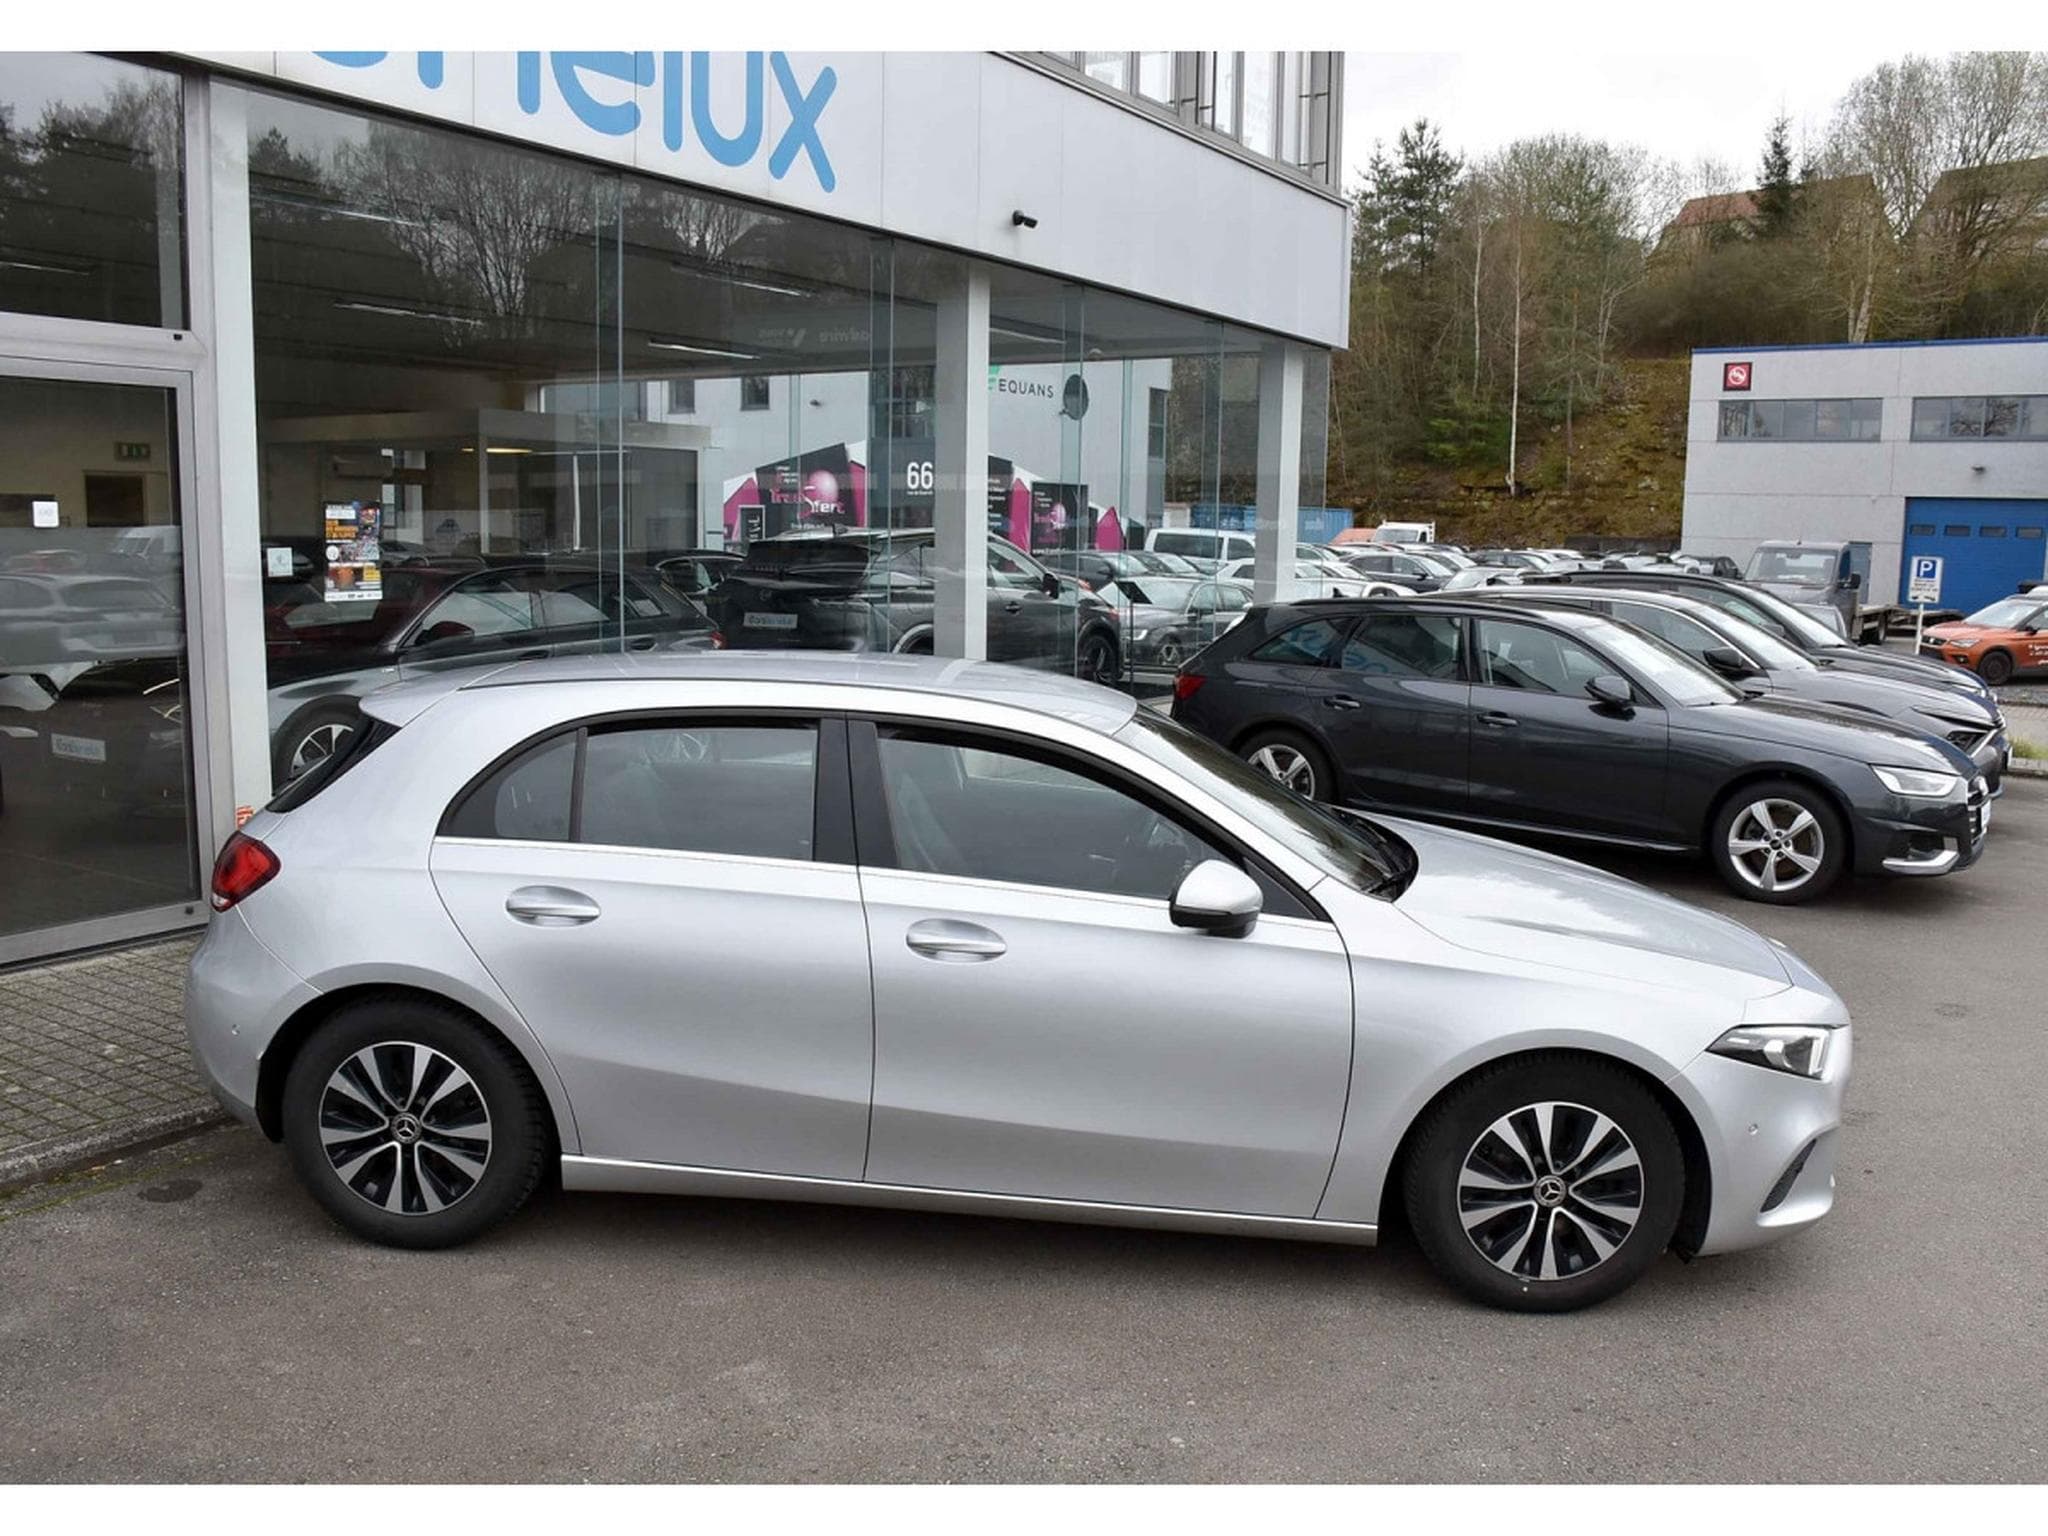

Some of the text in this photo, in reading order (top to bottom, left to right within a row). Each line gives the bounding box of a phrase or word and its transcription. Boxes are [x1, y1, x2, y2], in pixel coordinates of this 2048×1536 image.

[312, 51, 837, 193] elux
[998, 378, 1054, 399] EQUANS
[907, 461, 934, 490] 66
[1920, 560, 1933, 577] P
